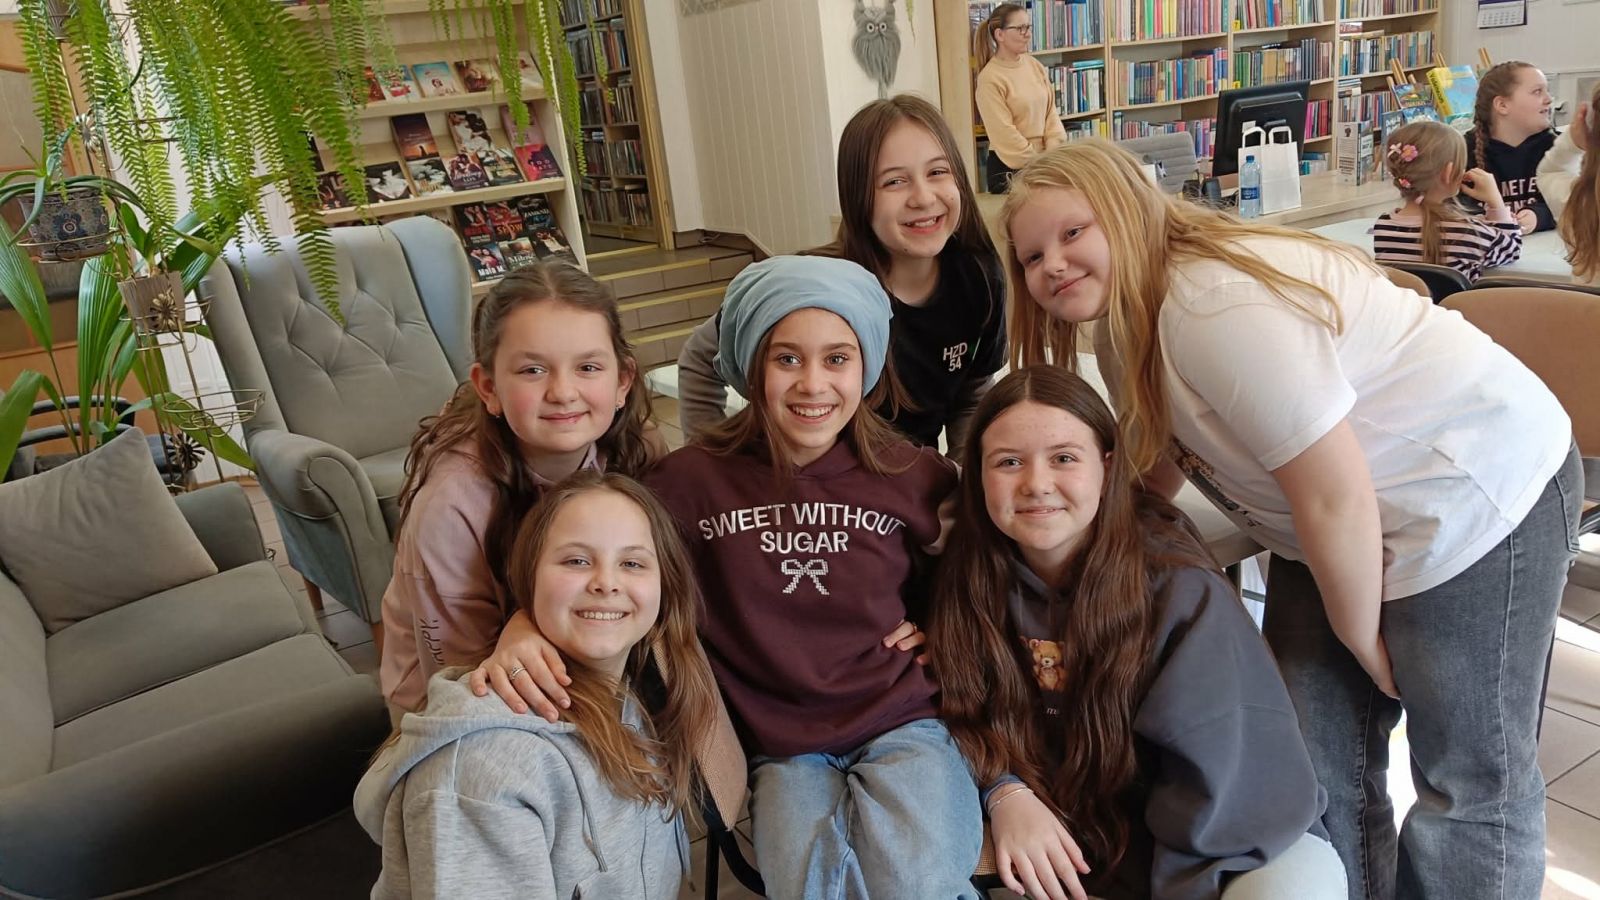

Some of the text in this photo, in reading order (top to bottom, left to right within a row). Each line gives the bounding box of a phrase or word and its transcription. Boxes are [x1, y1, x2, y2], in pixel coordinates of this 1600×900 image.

[942, 342, 968, 361] HZD
[948, 356, 962, 372] 54
[698, 502, 907, 541] SWEET WITHOUT
[760, 530, 849, 554] SUGAR
